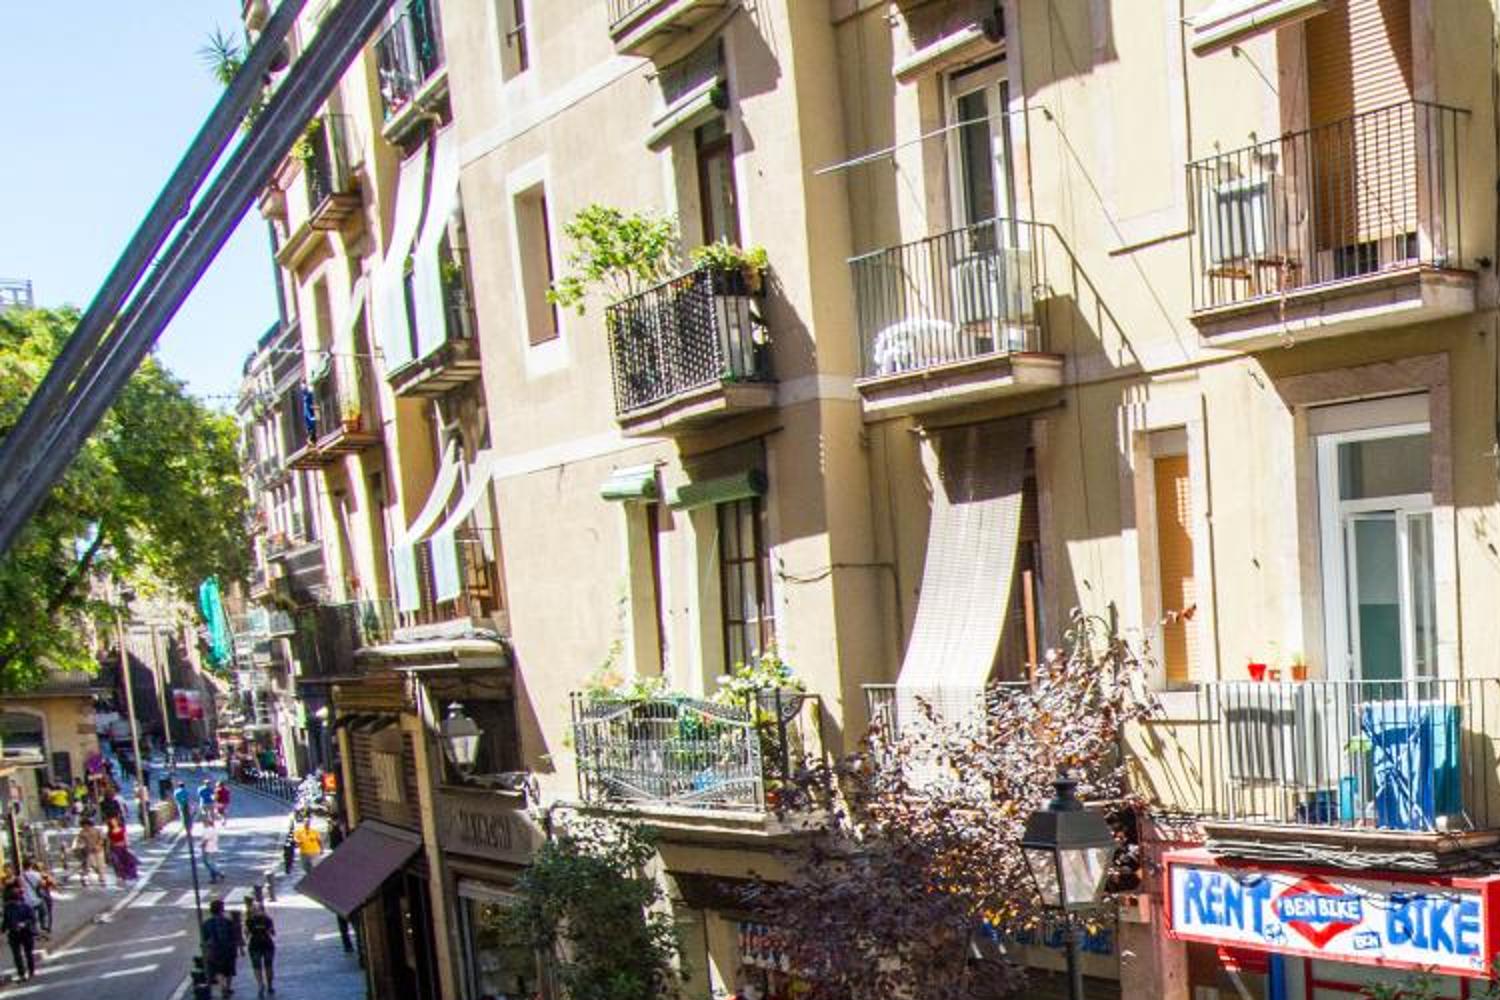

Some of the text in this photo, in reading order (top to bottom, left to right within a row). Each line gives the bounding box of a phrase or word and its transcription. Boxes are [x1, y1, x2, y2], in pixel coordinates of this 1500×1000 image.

[1183, 868, 1480, 955] RENT BIKE
[1285, 897, 1360, 919] BEN BIKE
